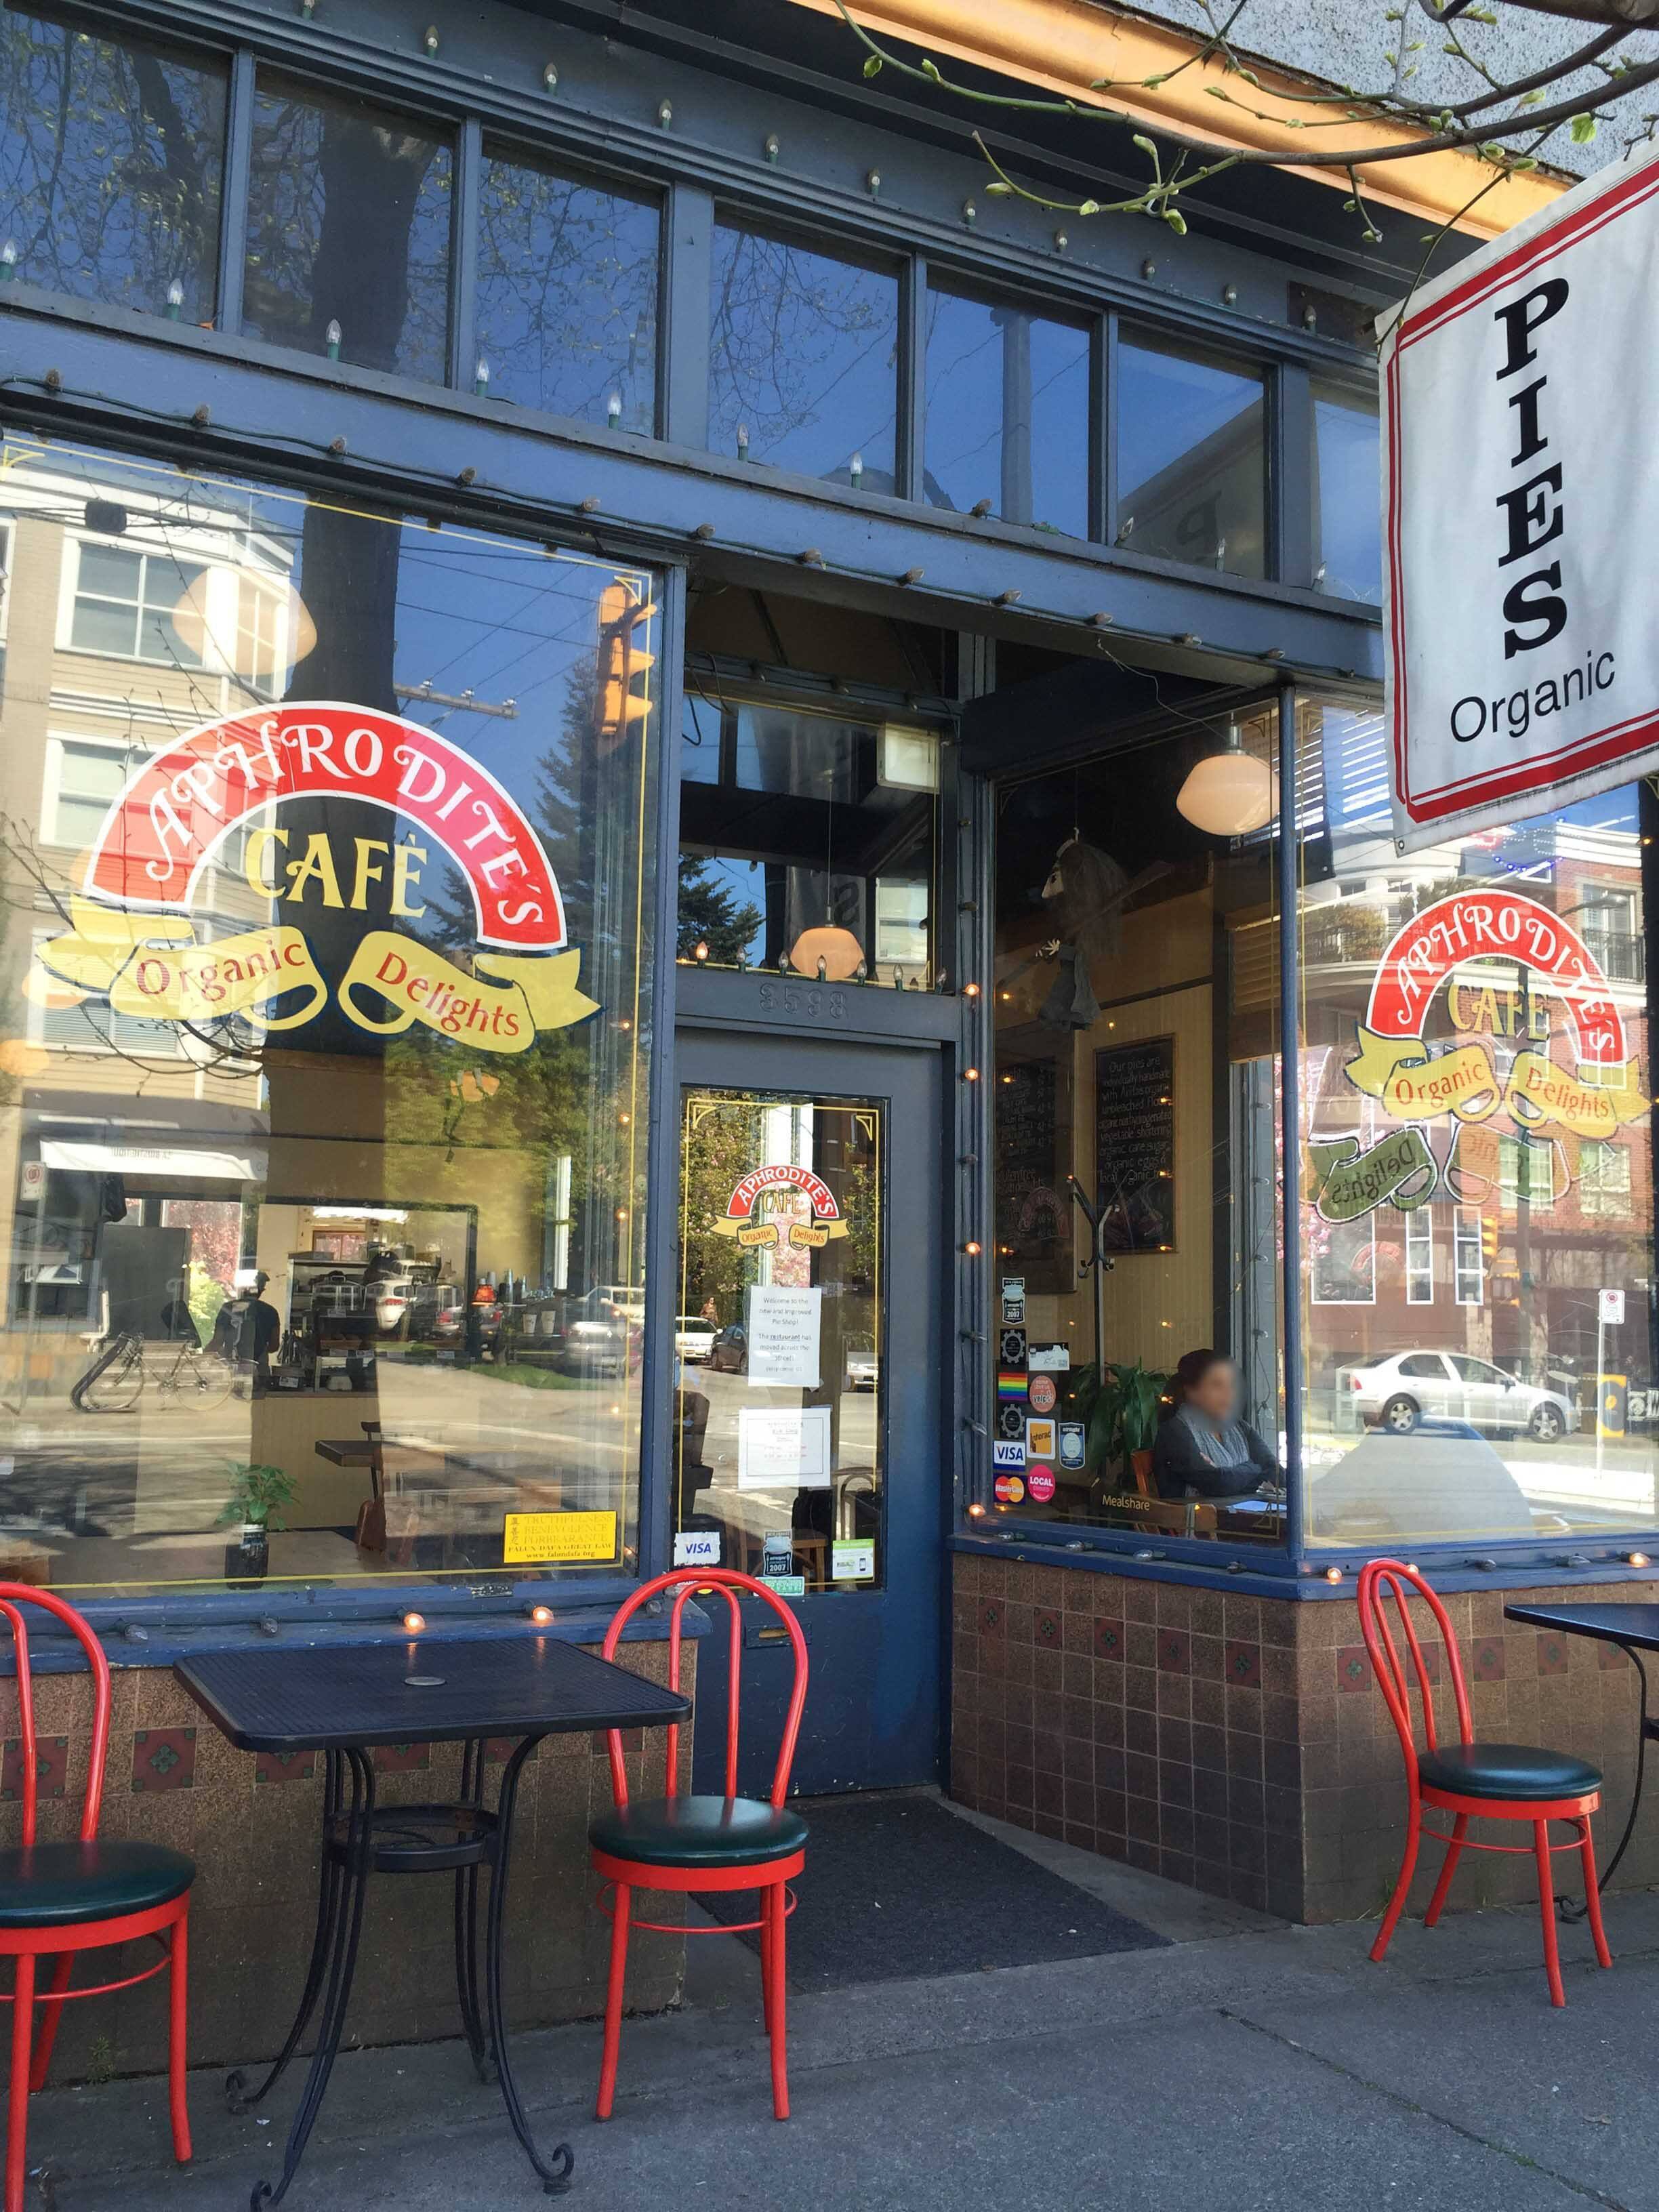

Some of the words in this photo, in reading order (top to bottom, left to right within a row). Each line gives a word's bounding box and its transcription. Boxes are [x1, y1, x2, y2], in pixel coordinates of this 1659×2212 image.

[1494, 276, 1570, 660] PIES
[1450, 649, 1616, 744] Organic
[145, 720, 544, 925] APHRODITE'S
[136, 940, 306, 1002] Organic
[375, 951, 520, 1038] Delights
[1395, 1061, 1486, 1109] Organic
[1525, 1066, 1610, 1121] Delights
[737, 1166, 834, 1214] APHRODITE'S
[794, 1229, 825, 1244] Delights
[770, 1333, 800, 1341] restaurant
[996, 1446, 1024, 1461] VISA
[1029, 1476, 1054, 1487] LOCAL
[1102, 1494, 1150, 1511] Mealshare
[685, 1542, 712, 1554] VISA
[769, 1563, 786, 1572] 2007
